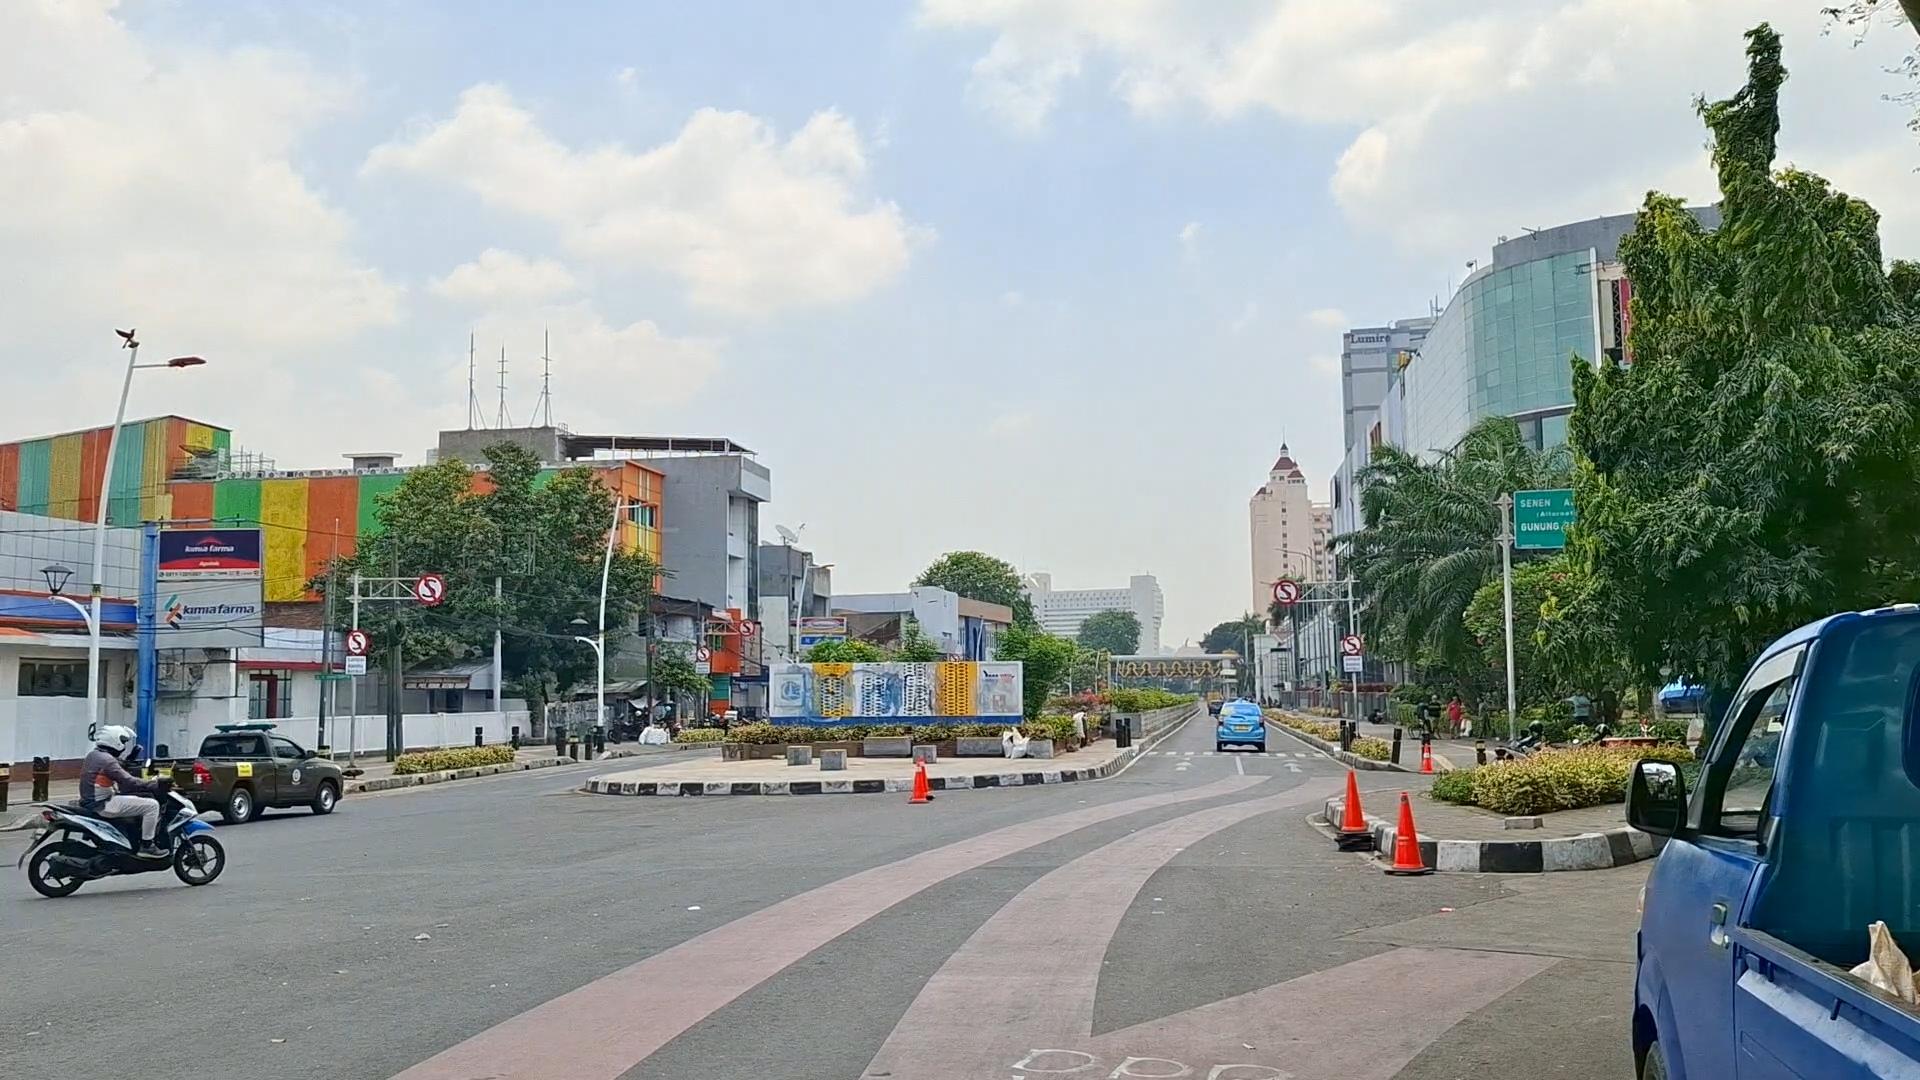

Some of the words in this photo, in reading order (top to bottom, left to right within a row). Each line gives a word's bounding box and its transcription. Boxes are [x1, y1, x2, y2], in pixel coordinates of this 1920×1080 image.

[1520, 499, 1551, 508] SENEN
[1520, 522, 1559, 531] GUNUNG
[185, 545, 208, 553] kimia
[209, 545, 235, 553] farma
[183, 605, 216, 615] kimia
[217, 604, 255, 615] farma
